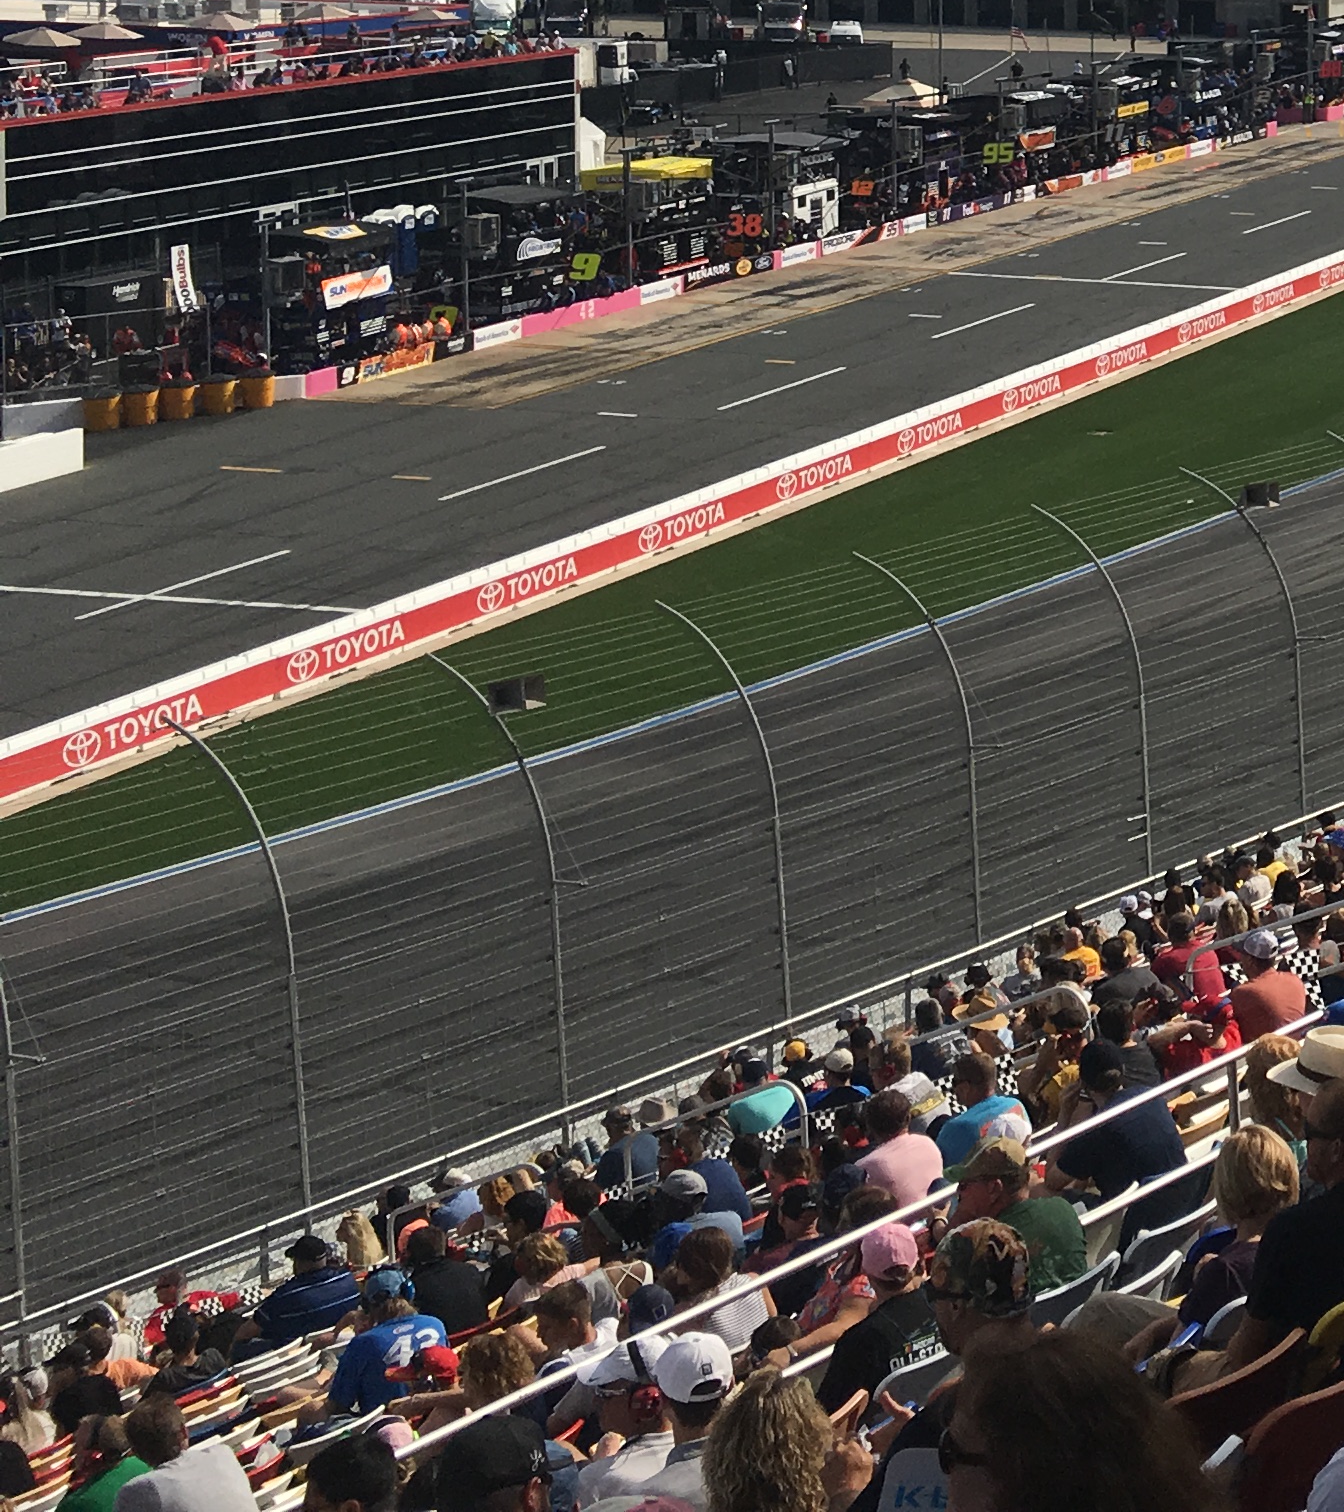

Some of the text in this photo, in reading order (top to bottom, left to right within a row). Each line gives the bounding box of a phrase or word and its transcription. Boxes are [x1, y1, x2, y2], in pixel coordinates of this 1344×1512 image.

[982, 142, 1015, 164] 95
[726, 214, 763, 238] 38
[569, 253, 601, 281] 9
[688, 262, 731, 283] MENARDS
[1264, 284, 1294, 305] TOYOTA
[1192, 312, 1226, 336] TOYOTA
[1110, 342, 1148, 370] TOYOTA
[1018, 375, 1061, 405] TOYOTA
[916, 413, 963, 445] TOYOTA
[799, 454, 853, 491] TOYOTA
[664, 502, 726, 542] TOYOTA
[507, 557, 578, 601] TOYOTA
[322, 620, 405, 670] TOYOTA
[103, 694, 204, 751] TOYOTA
